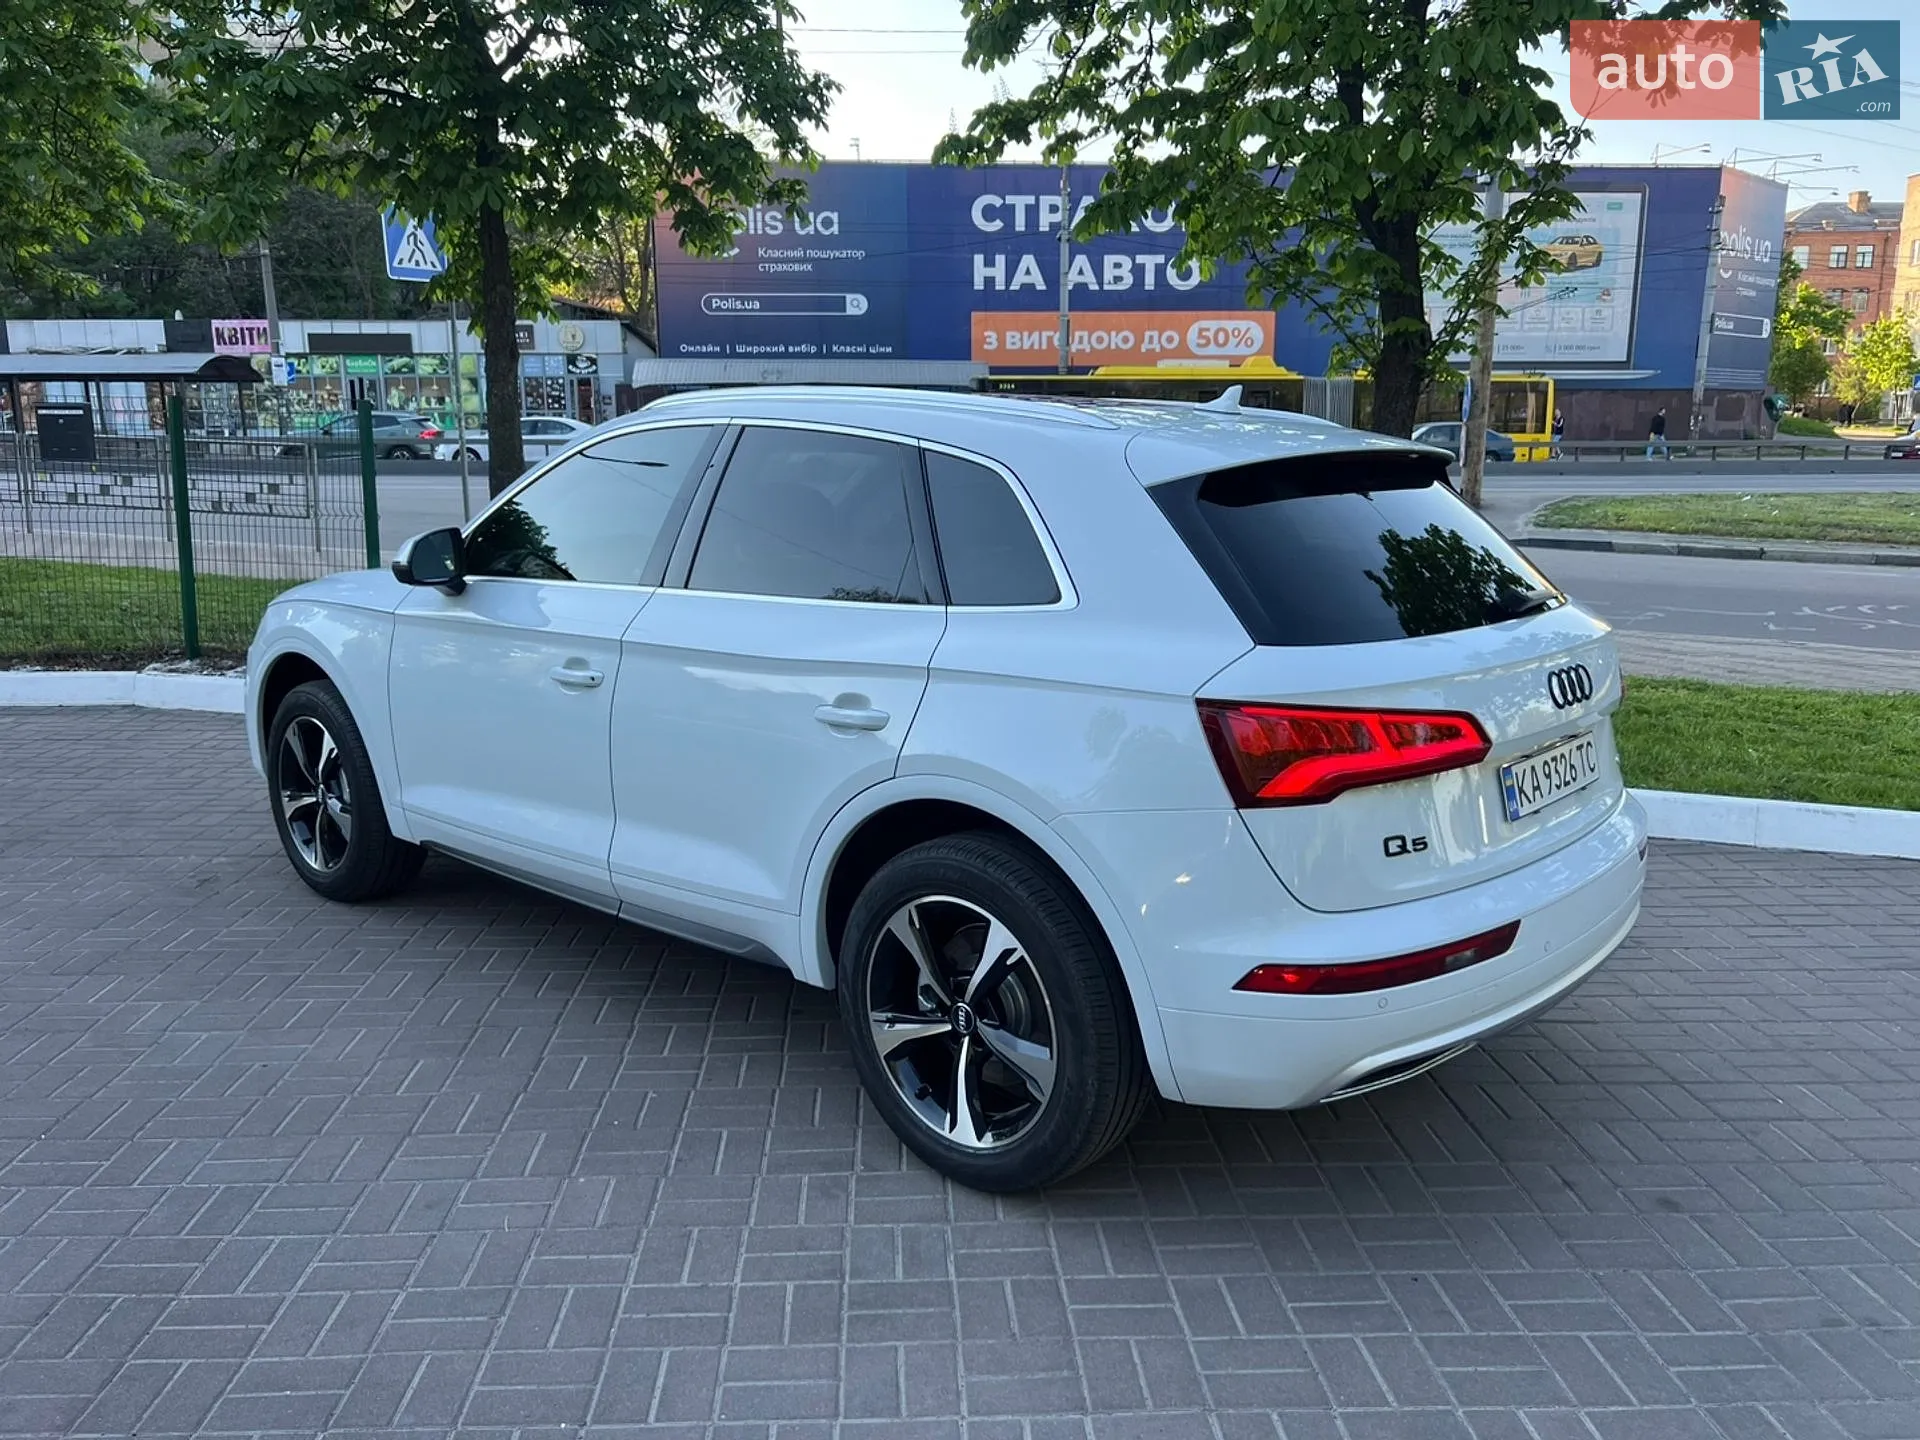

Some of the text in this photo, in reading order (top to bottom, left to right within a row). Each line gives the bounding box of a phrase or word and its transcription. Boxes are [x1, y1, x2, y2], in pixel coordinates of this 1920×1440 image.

[758, 247, 804, 258] Класний
[758, 262, 813, 274] страхових
[973, 254, 1202, 291] НА АВТО
[711, 298, 760, 310] Polis.ua
[215, 327, 269, 346] КВІТИ
[1196, 326, 1255, 349] 50%
[680, 343, 893, 355] Онлайн Широкий вибір Класні ціни
[1515, 741, 1596, 808] KA 9326 TC
[1383, 834, 1428, 858] Q5
